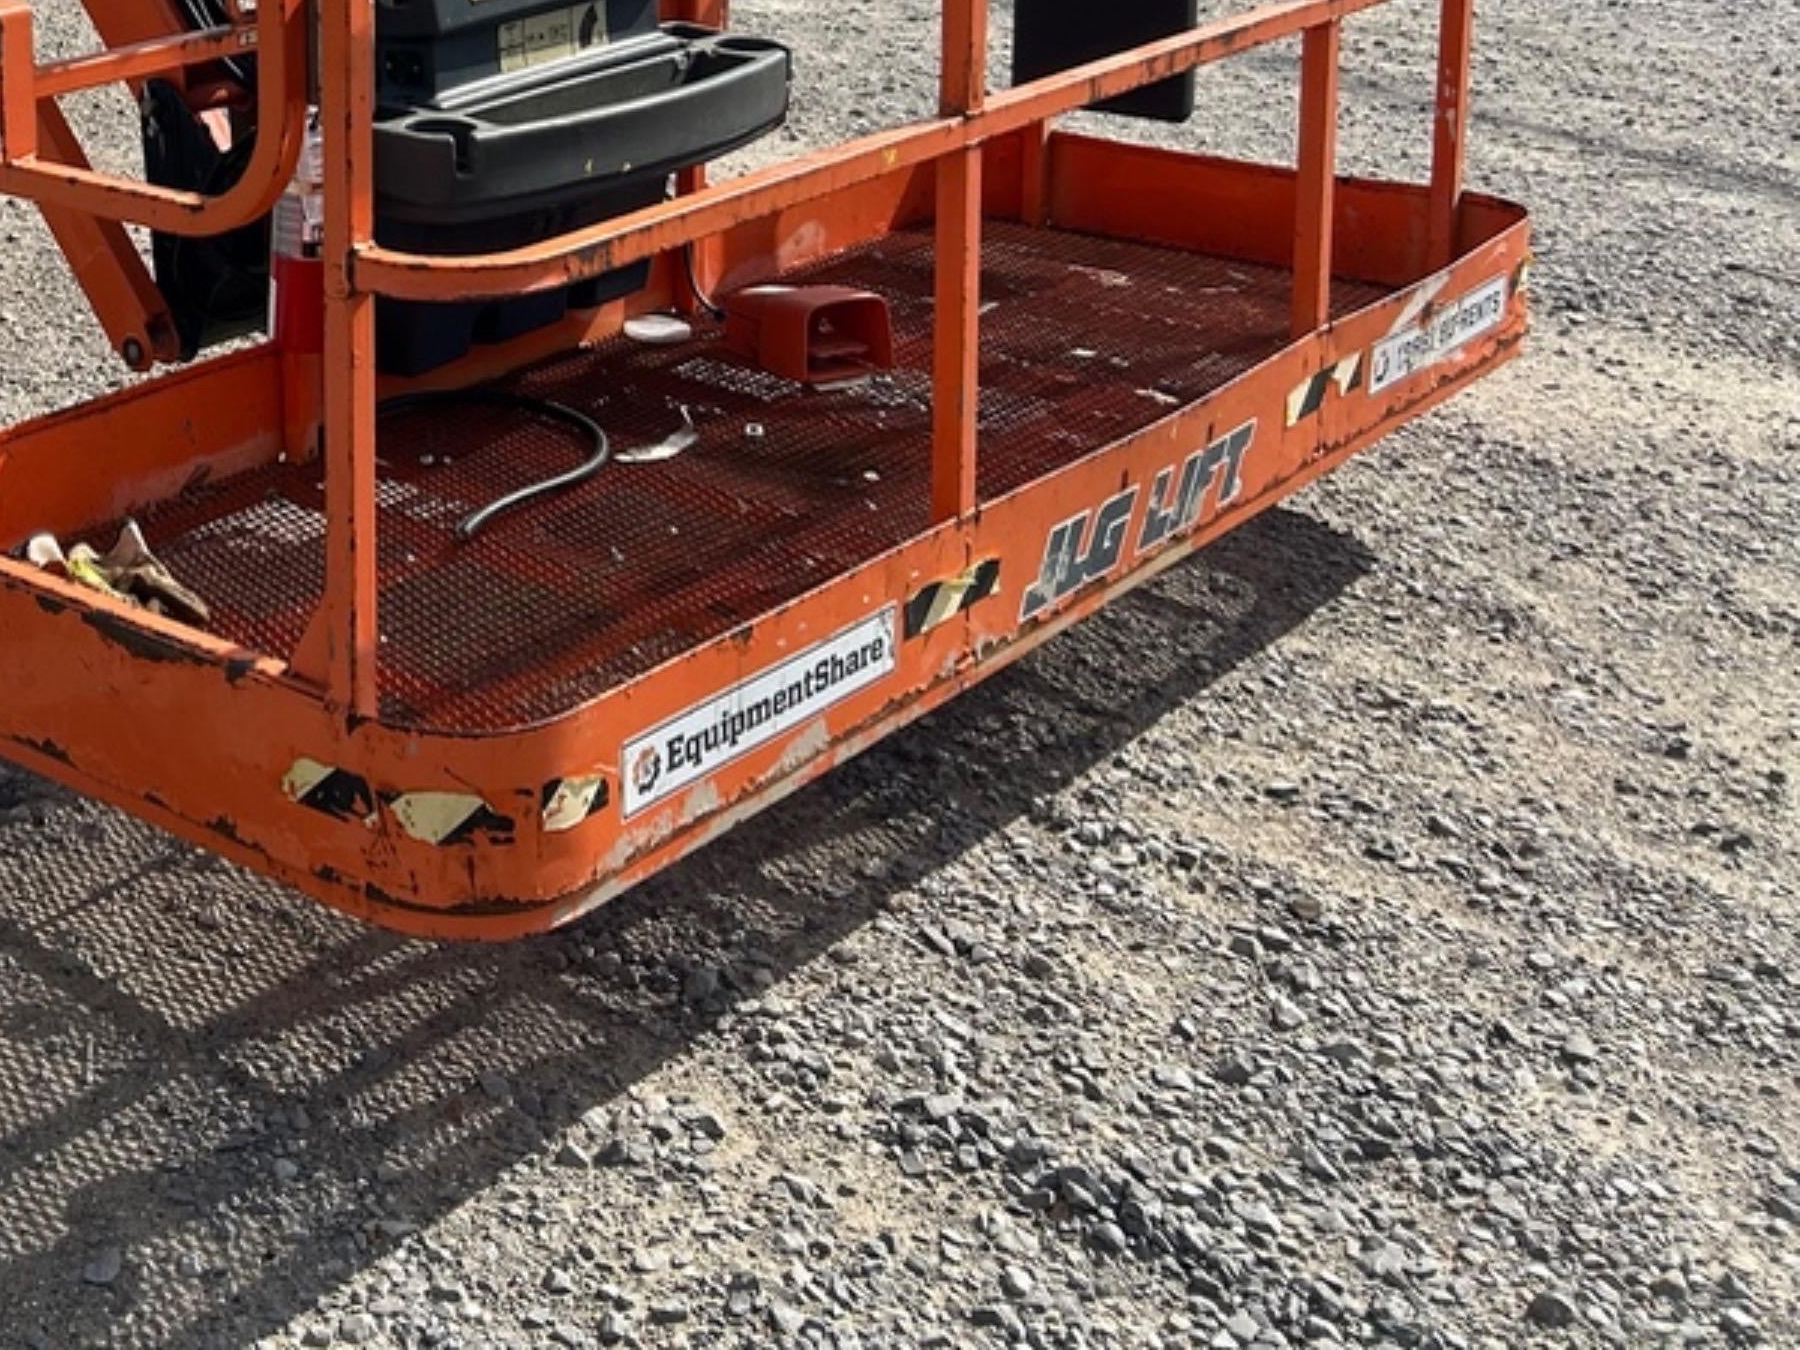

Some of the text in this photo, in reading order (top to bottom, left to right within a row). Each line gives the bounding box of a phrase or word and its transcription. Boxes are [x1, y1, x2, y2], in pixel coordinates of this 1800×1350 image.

[1018, 416, 1259, 623] JLG LIFT
[664, 637, 886, 773] EquipmentShare
